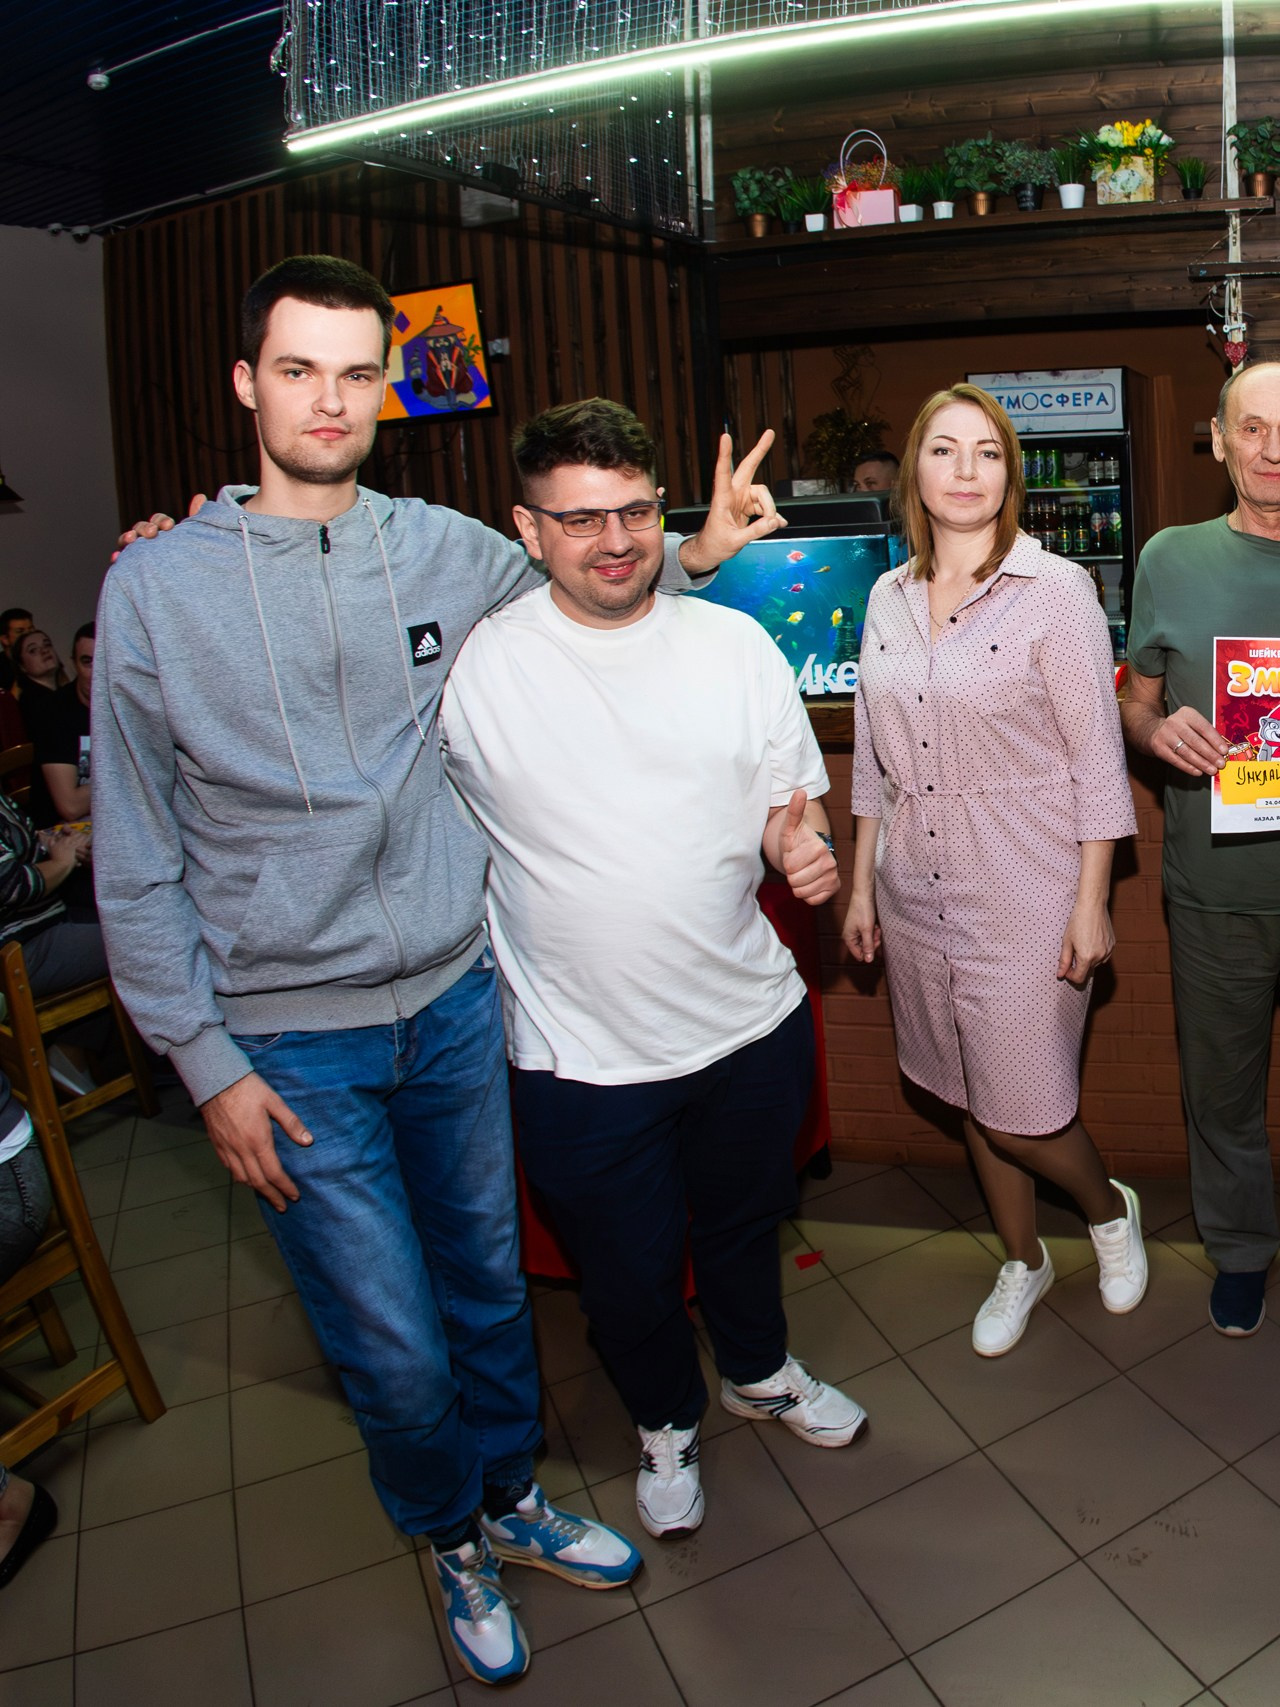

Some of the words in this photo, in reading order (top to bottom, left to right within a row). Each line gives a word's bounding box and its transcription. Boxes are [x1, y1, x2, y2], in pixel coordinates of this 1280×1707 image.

[996, 391, 1110, 412] ТМОСФЕРА
[414, 644, 441, 658] adidas
[1228, 662, 1253, 696] 3
